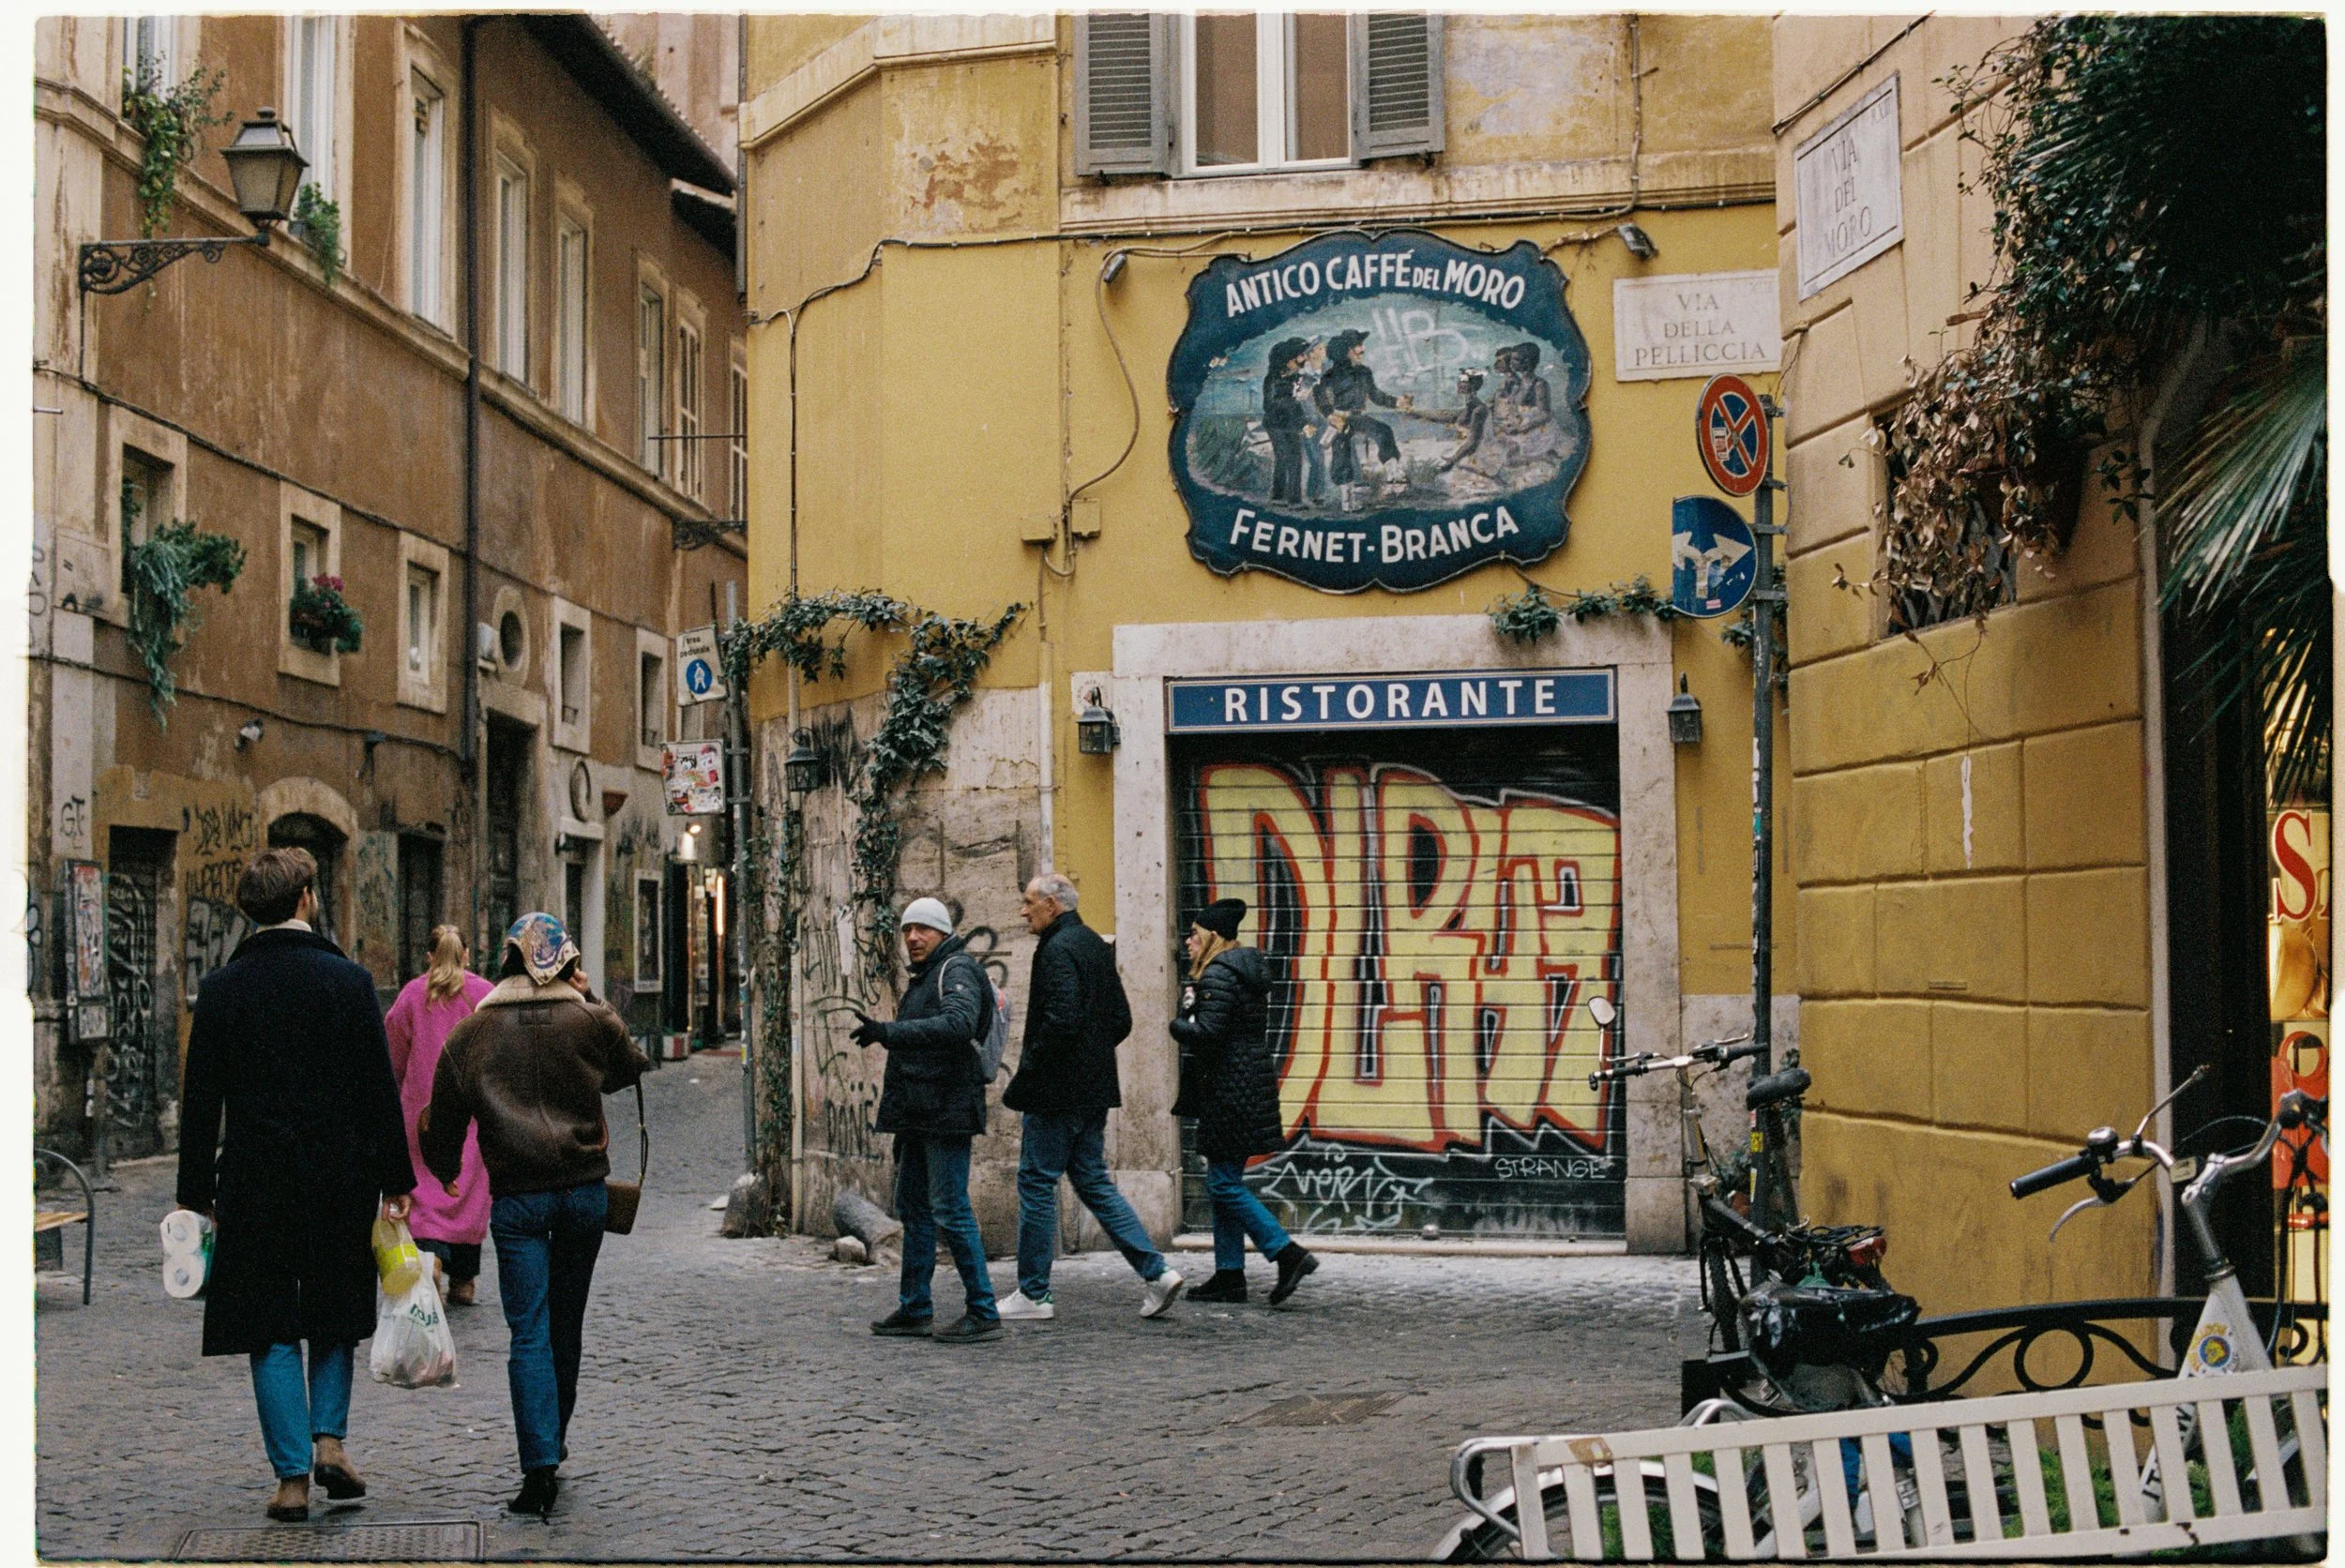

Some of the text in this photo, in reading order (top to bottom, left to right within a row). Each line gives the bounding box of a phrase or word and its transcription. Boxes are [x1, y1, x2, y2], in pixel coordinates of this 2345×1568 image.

[1831, 136, 1857, 174] VIA
[1834, 176, 1856, 213] DEL
[1226, 262, 1321, 318] ANTICO
[1412, 266, 1440, 291] DEL
[1443, 259, 1525, 309] MORO
[1677, 293, 1719, 311] VIA
[1664, 321, 1735, 339] DELLA
[1635, 341, 1766, 367] PELLICCIA
[1224, 679, 1556, 722] RISTORANTE
[1494, 1156, 1607, 1181] STRANGE
